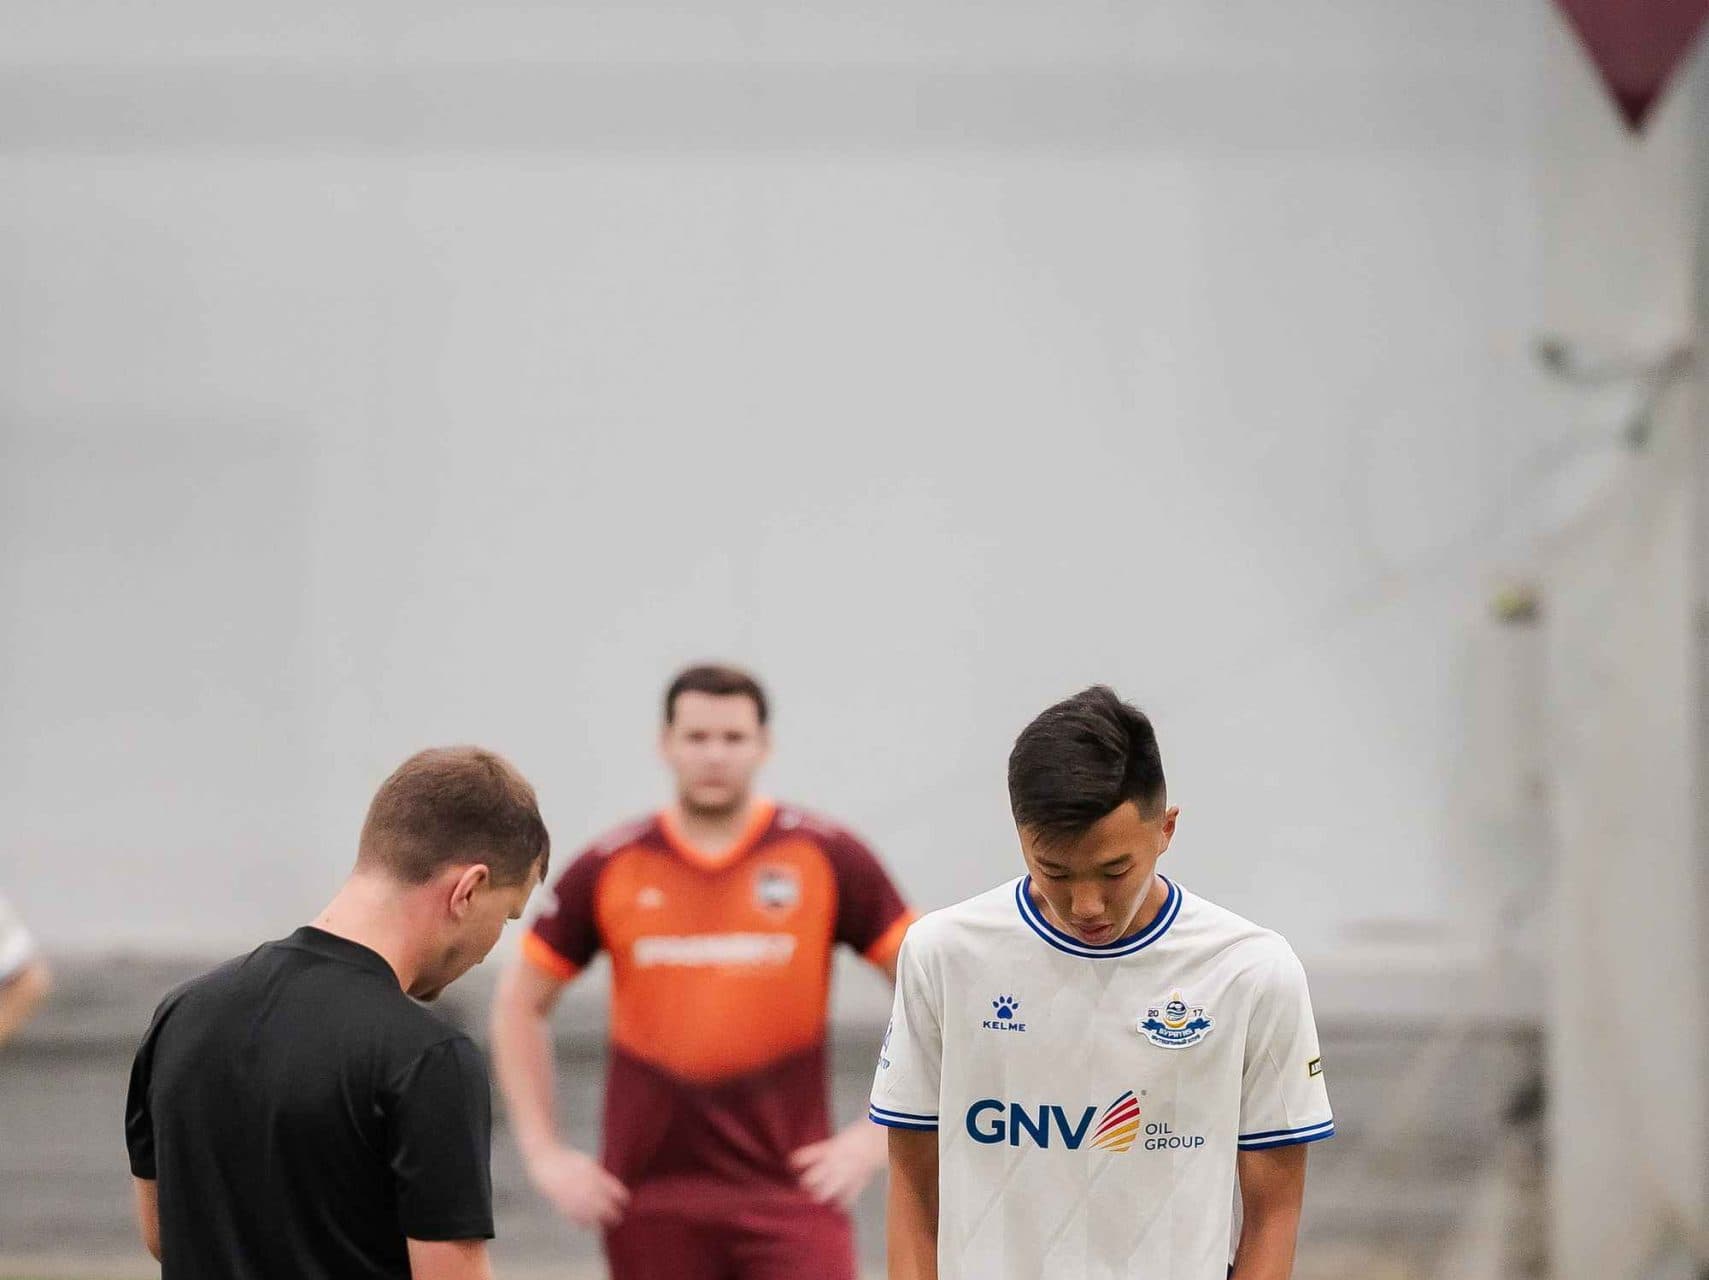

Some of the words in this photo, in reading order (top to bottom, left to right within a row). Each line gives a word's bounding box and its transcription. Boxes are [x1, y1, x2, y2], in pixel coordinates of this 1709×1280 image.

[1148, 1009, 1159, 1017] 20
[1193, 1009, 1203, 1017] 17
[983, 1021, 1026, 1032] KELME
[966, 1099, 1098, 1150] GNV
[1145, 1122, 1173, 1135] OIL
[1144, 1136, 1205, 1151] GROUP
